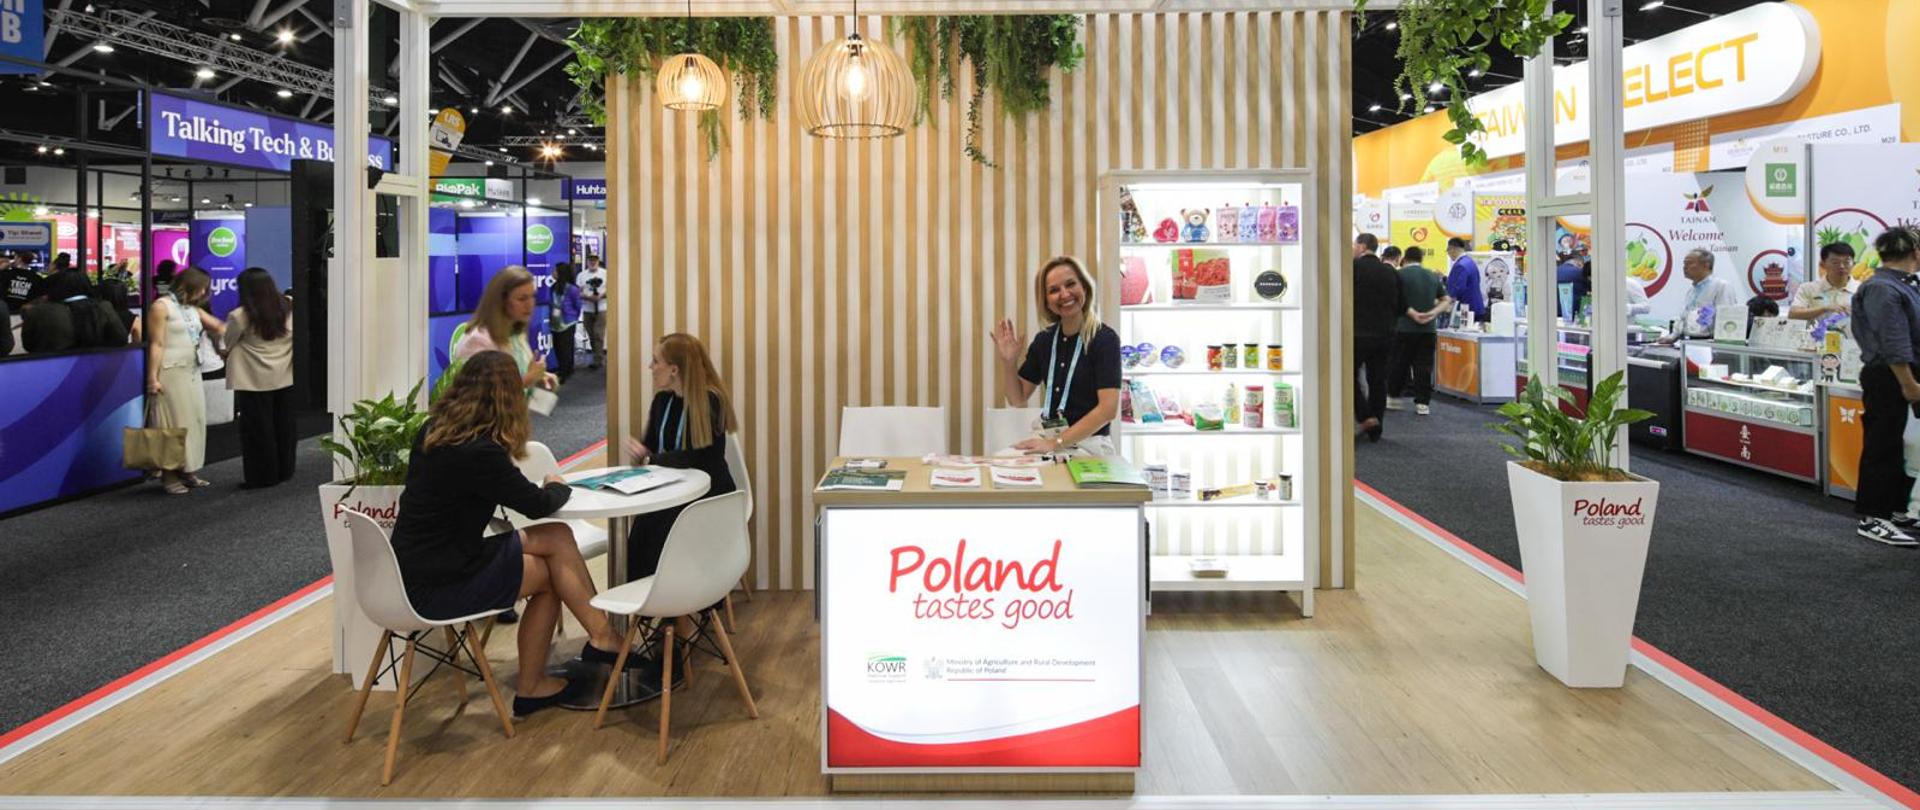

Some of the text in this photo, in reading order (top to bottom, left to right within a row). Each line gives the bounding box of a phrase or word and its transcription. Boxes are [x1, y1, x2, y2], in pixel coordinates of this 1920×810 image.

[1623, 32, 1759, 109] ELECT
[161, 111, 246, 153] Talking
[249, 127, 296, 156] Tech
[299, 136, 314, 159] &
[1680, 216, 1717, 224] TAINAN
[1668, 229, 1724, 242] Welcome
[1573, 497, 1642, 516] Poland
[1583, 514, 1646, 529] tastes good
[889, 538, 1063, 593] Poland
[912, 588, 1074, 629] tastes good
[867, 661, 906, 673] KOWR
[945, 658, 973, 667] Ministry
[983, 658, 1019, 668] Agriculture
[1020, 658, 1032, 666] and
[1051, 659, 1096, 668] Development
[945, 666, 973, 676] Republic
[984, 666, 1007, 674] Poland
